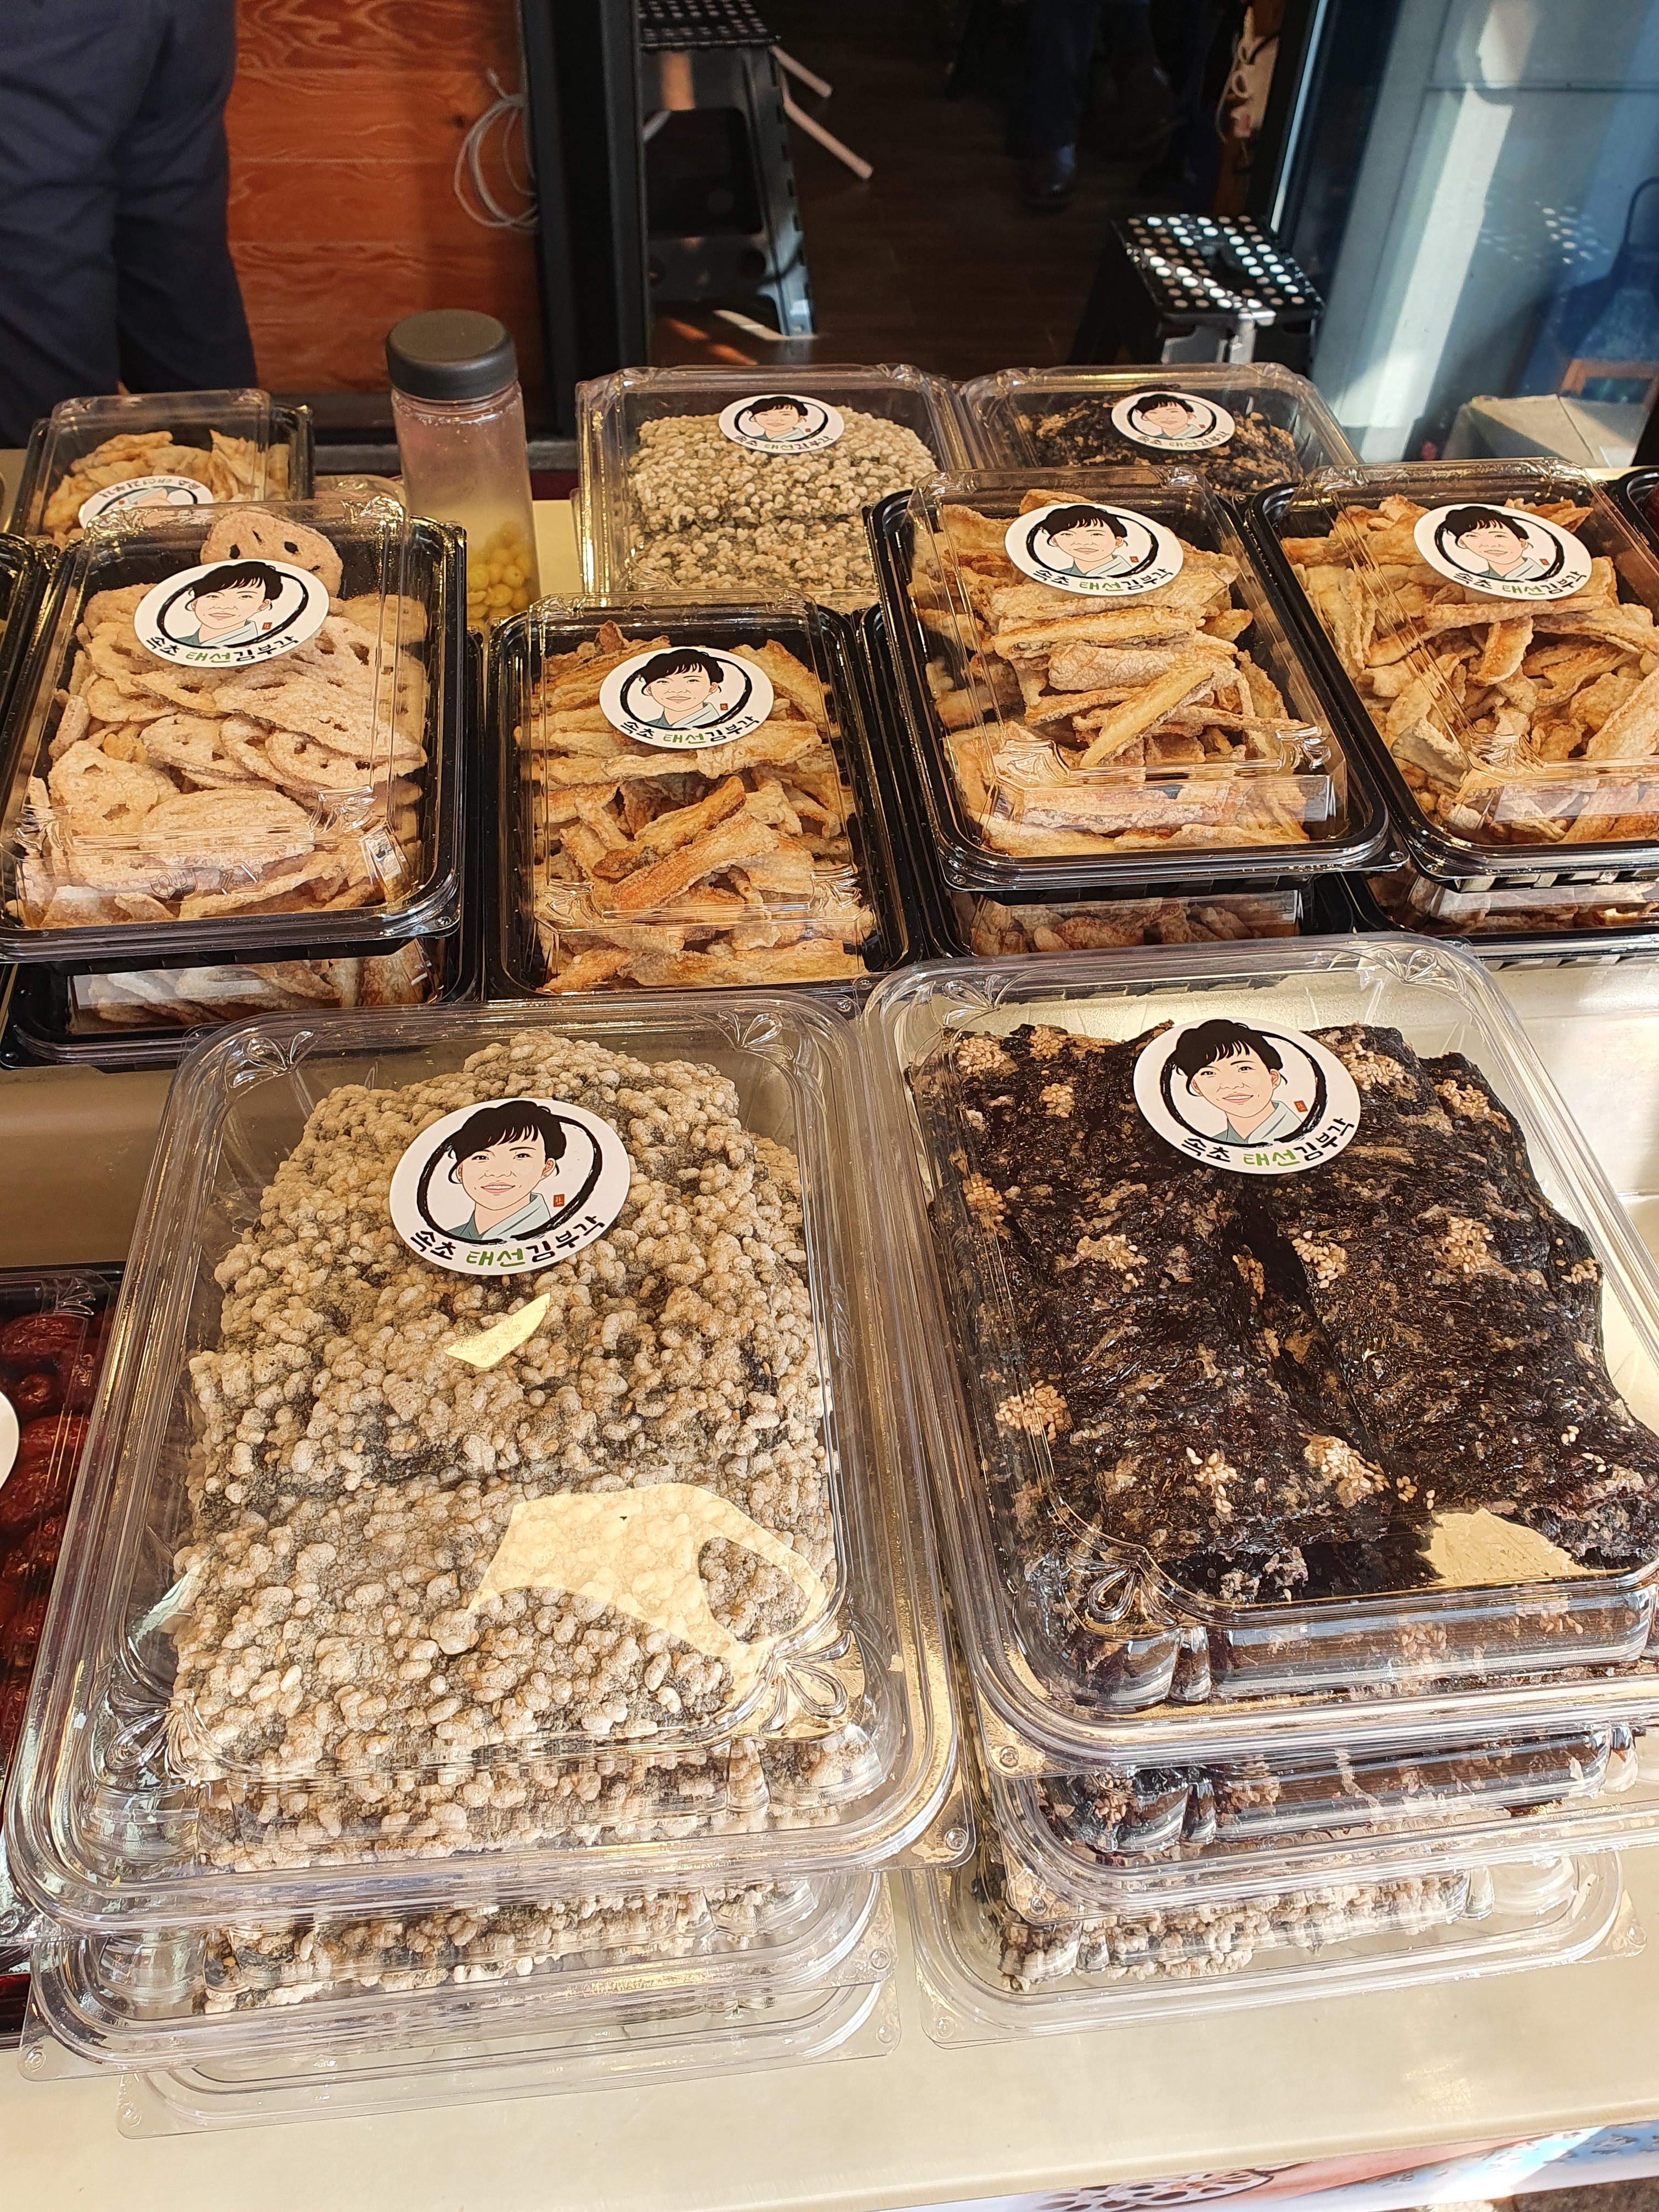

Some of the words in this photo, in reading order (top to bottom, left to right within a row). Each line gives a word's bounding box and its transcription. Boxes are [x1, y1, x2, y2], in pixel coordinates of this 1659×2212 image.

[1032, 569, 1070, 586] 속초
[1453, 572, 1493, 590] 속초
[145, 636, 180, 657] 속초
[620, 721, 656, 740] 속초
[1182, 1137, 1231, 1163] 속초
[410, 1229, 457, 1260] 속초
